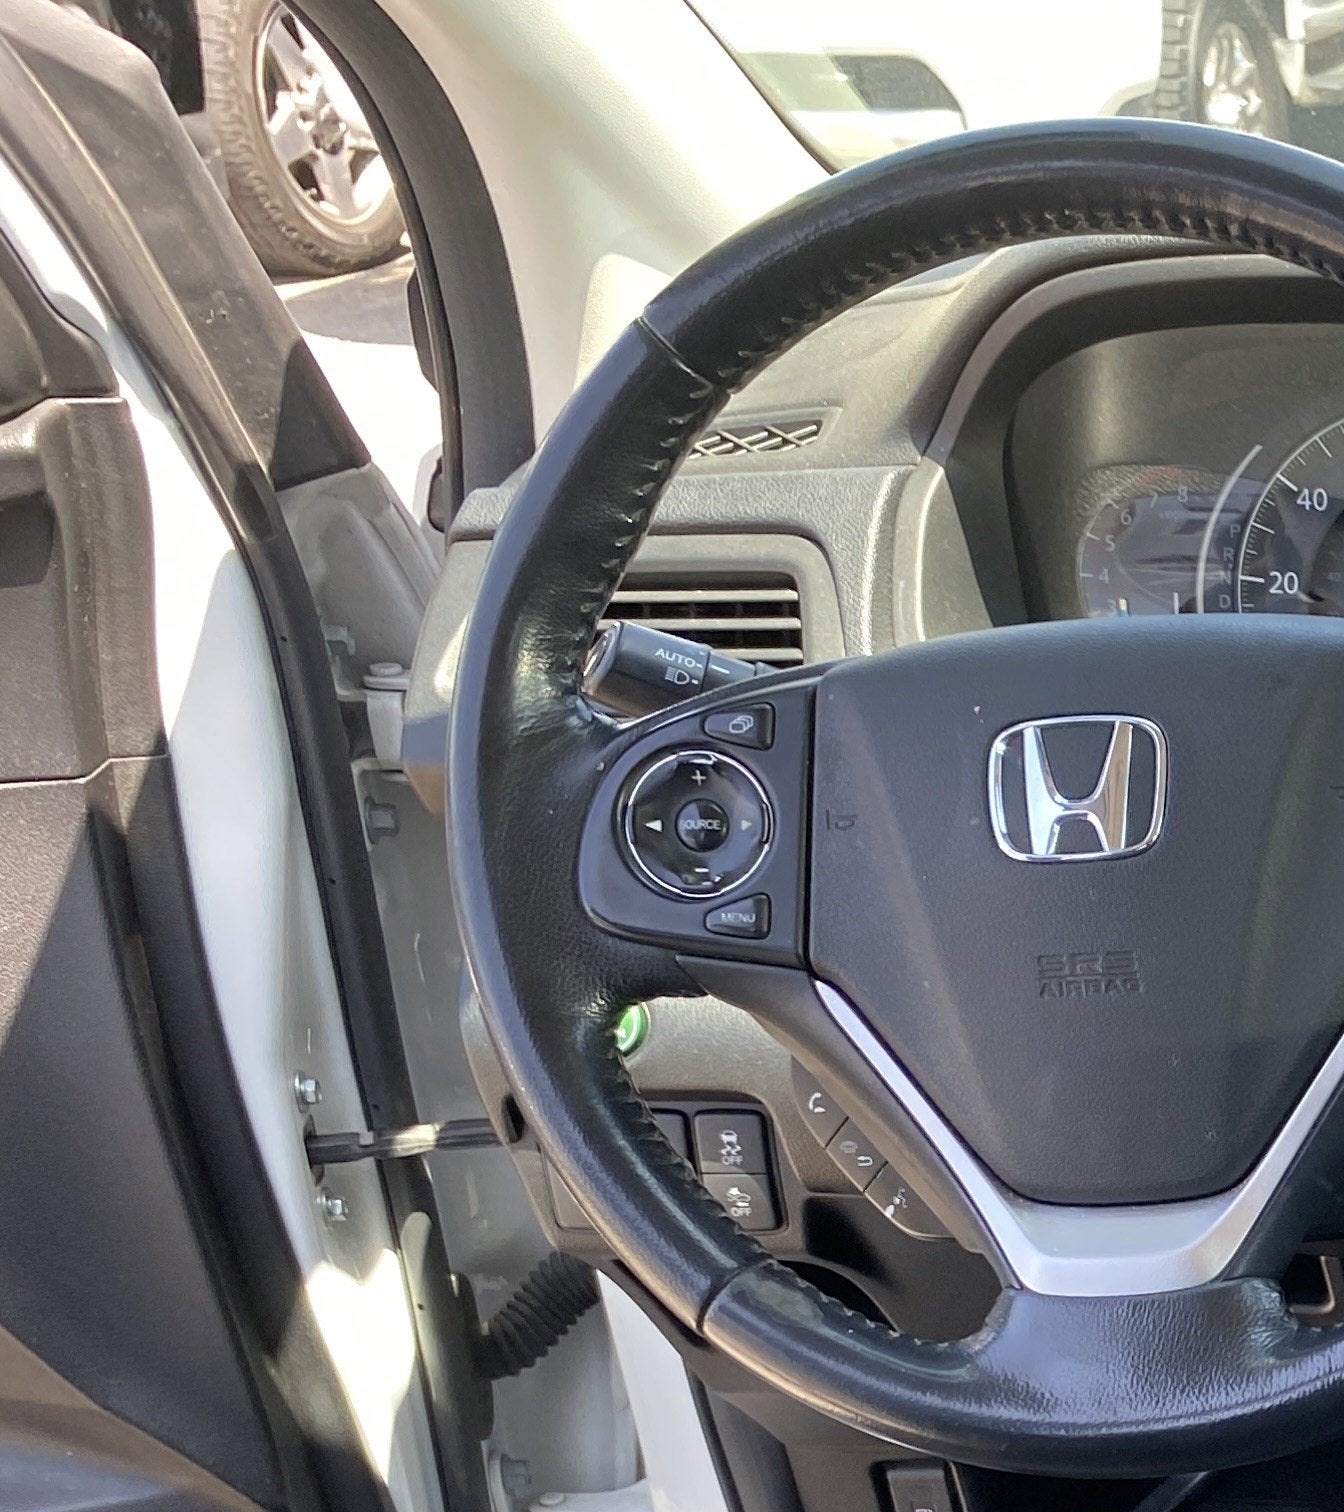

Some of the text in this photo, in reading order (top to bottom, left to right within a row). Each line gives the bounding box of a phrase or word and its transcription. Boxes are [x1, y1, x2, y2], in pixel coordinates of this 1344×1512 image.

[1177, 486, 1188, 502] 8
[1296, 489, 1328, 511] 40
[1121, 511, 1132, 525] 6
[1229, 525, 1240, 537] P
[1105, 535, 1115, 551] 5
[1223, 548, 1233, 560] R
[1098, 568, 1109, 584] 4
[1269, 571, 1299, 594] 20
[1219, 595, 1230, 608] D
[655, 647, 696, 668] AUTO
[679, 818, 721, 832] SOURCE
[721, 912, 755, 924] MENU
[722, 1155, 743, 1165] OFF
[731, 1207, 752, 1217] OFF
